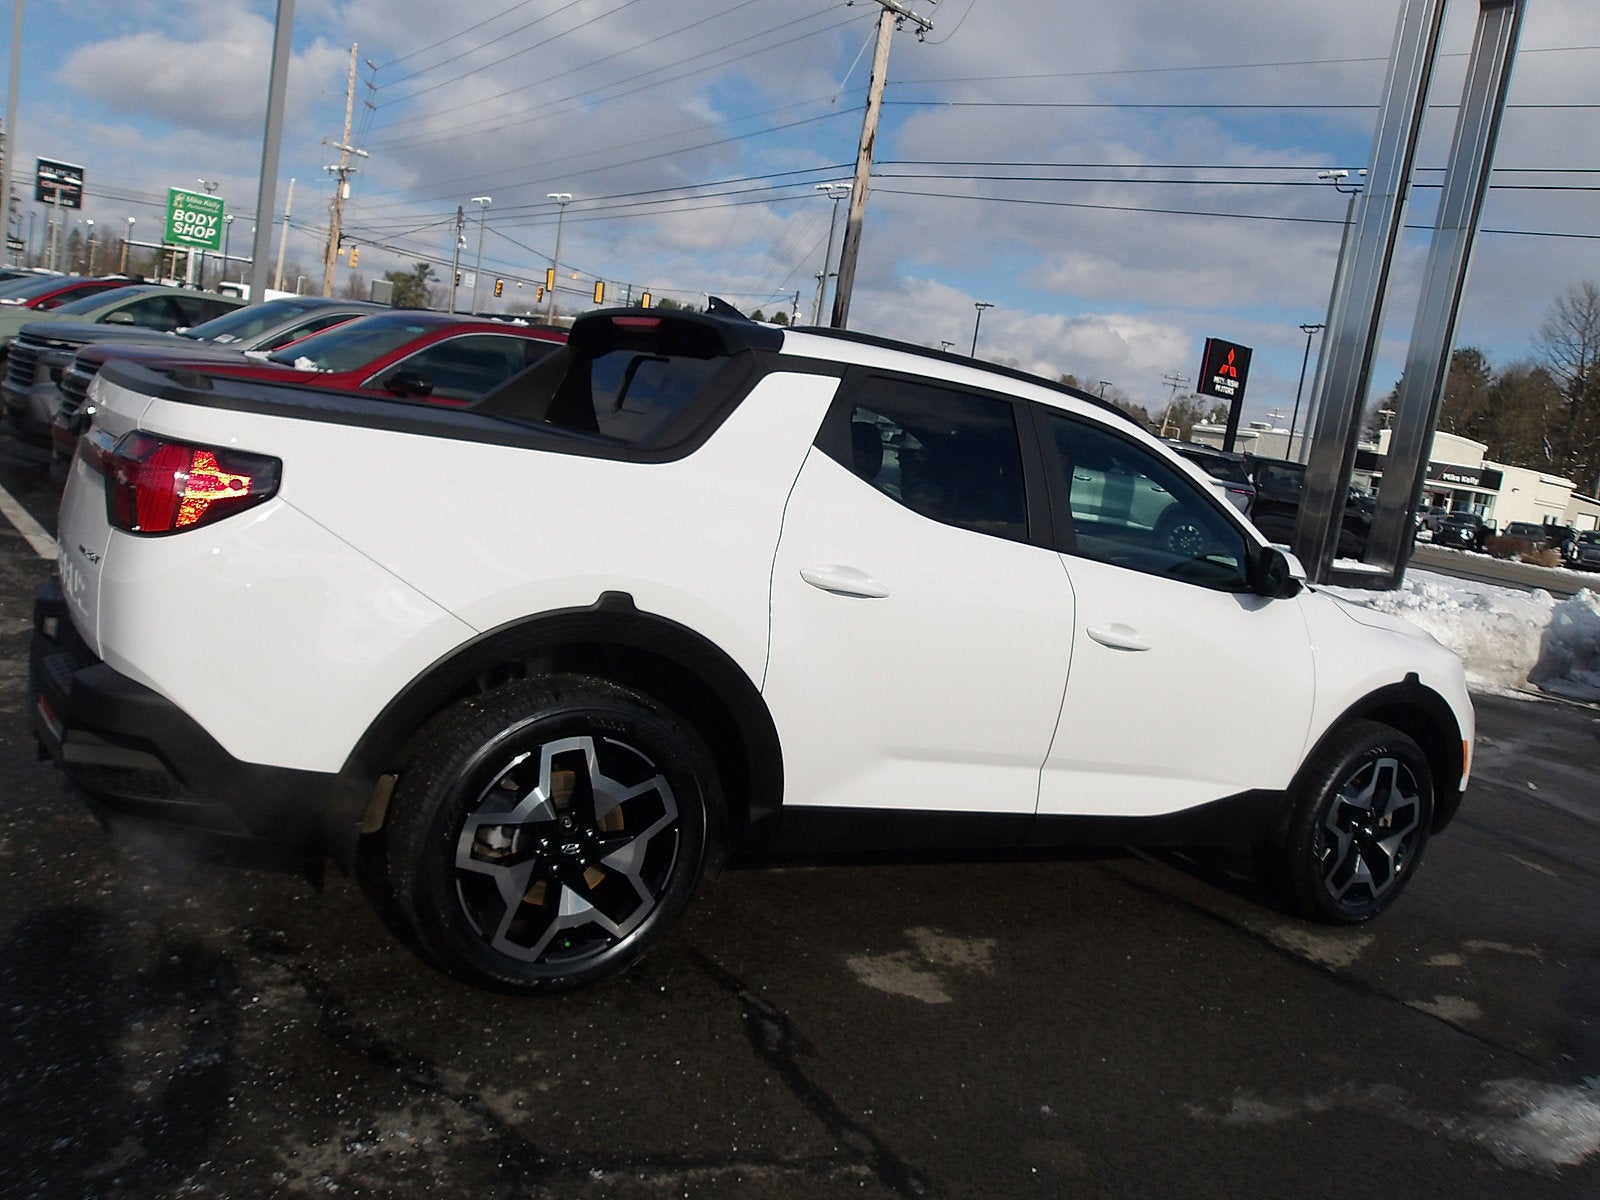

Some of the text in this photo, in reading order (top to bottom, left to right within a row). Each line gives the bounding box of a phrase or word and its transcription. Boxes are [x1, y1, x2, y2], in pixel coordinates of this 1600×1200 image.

[186, 196, 220, 210] Mike Kelly
[172, 208, 218, 227] BODY
[172, 221, 216, 239] SHOP
[1442, 473, 1479, 486] Mike Kelly
